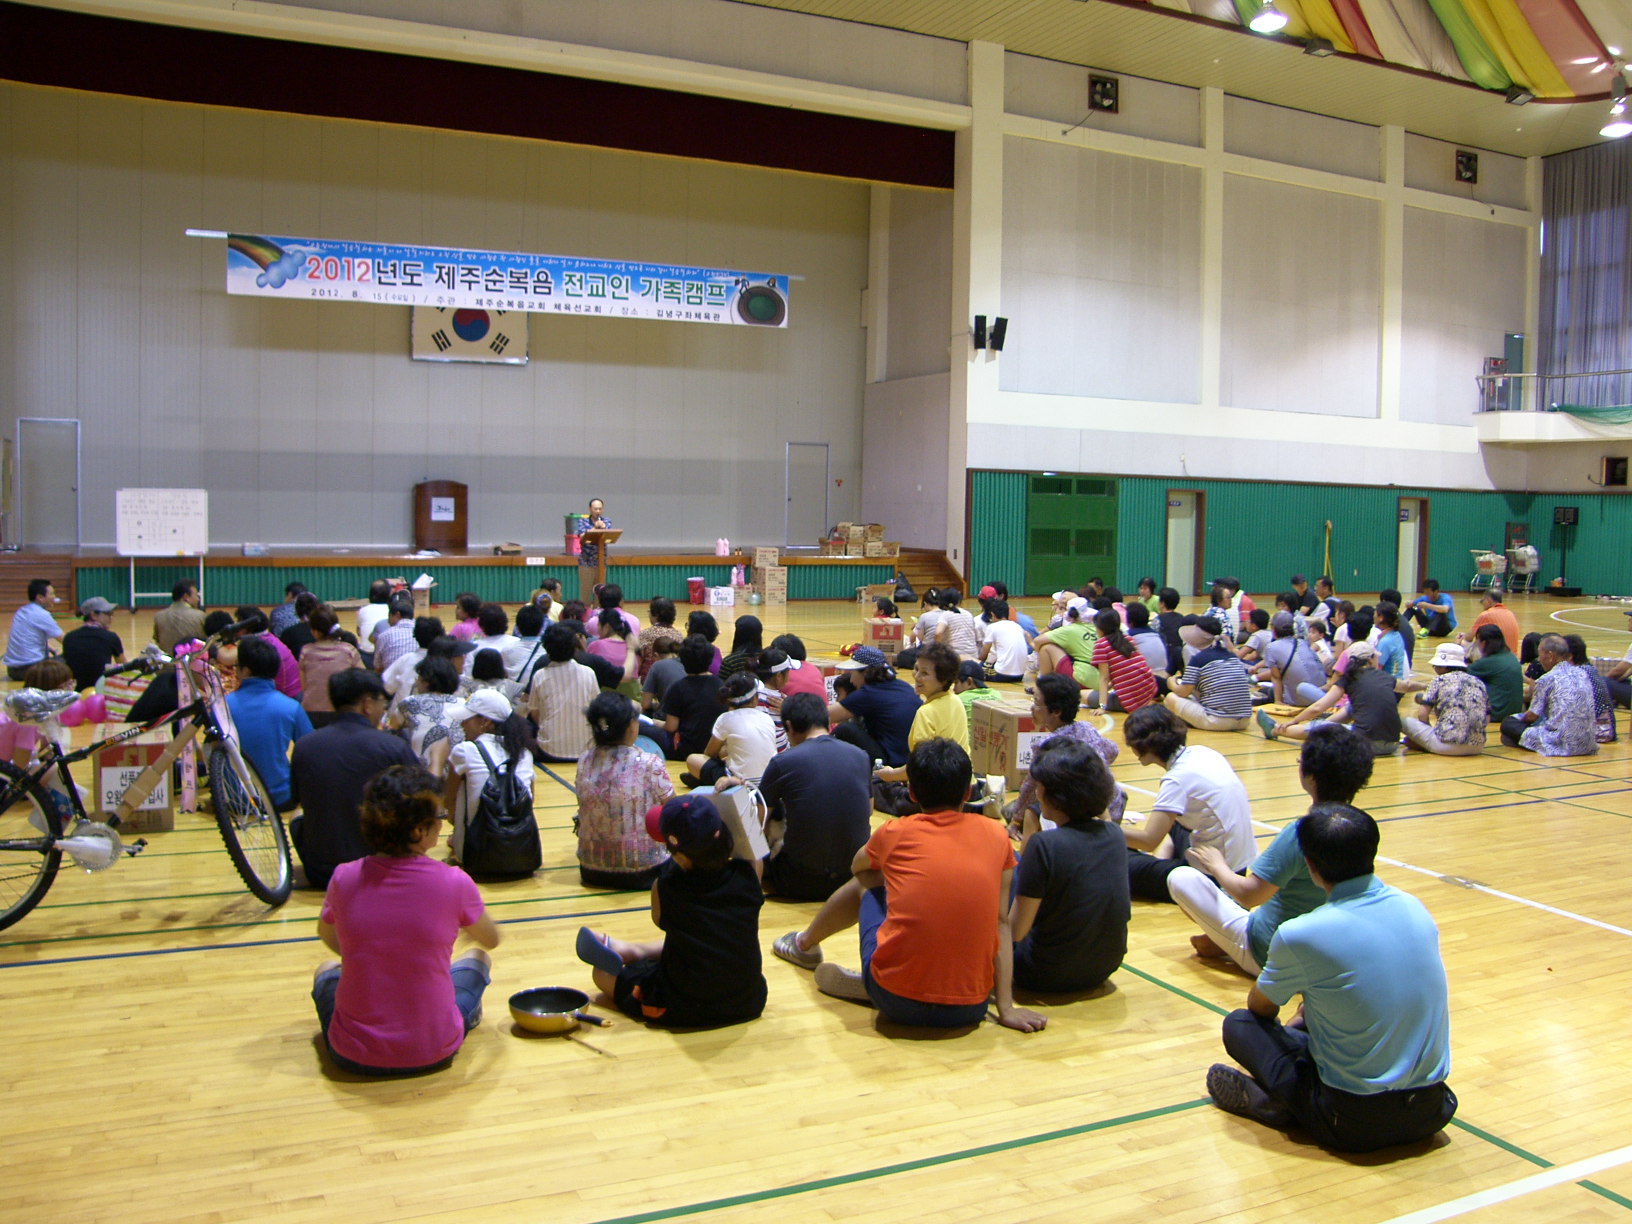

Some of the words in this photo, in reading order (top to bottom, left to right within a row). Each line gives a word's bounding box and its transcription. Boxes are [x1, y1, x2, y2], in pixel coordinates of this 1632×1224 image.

[307, 256, 422, 286] 2012년도
[434, 263, 552, 295] 제주순복음
[564, 272, 629, 300] 전교인
[641, 278, 725, 306] 가족캠프
[475, 298, 546, 311] 제주순복음교회
